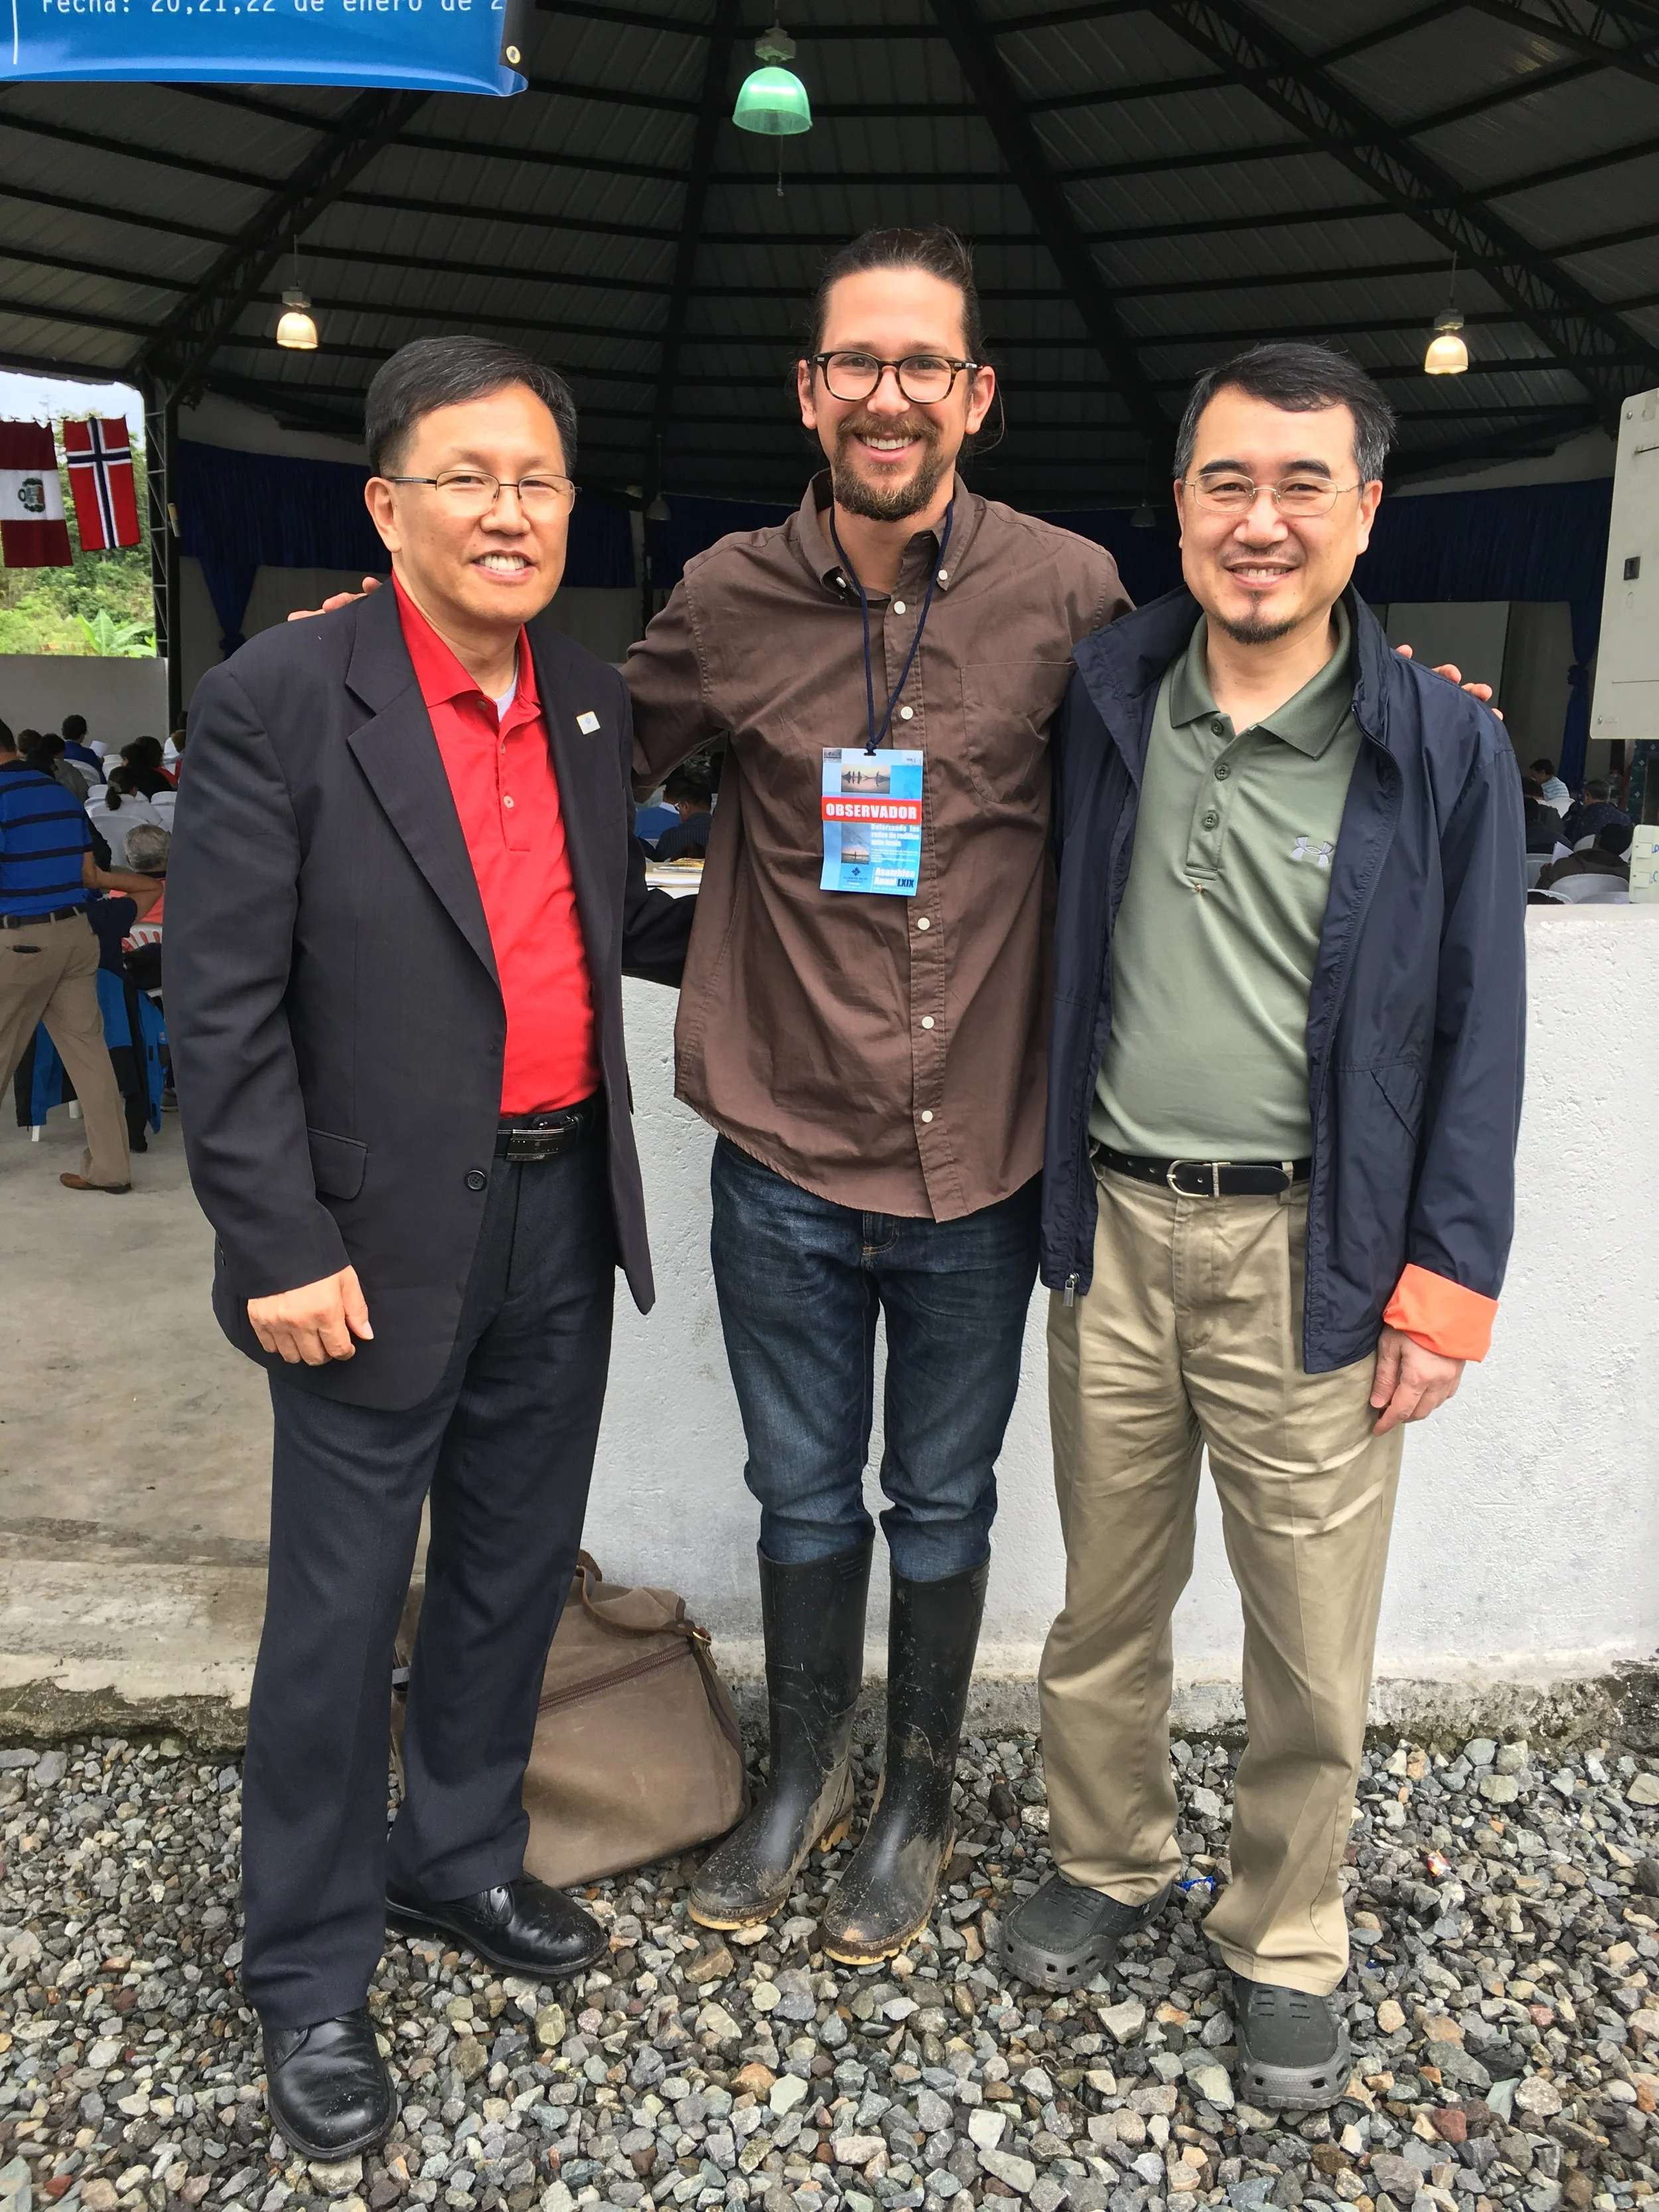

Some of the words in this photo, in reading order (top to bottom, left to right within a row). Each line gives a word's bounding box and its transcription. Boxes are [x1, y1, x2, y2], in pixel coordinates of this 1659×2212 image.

[294, 0, 324, 12] de
[343, 0, 422, 11] enero
[441, 0, 471, 11] de
[826, 803, 917, 820] OBSERVADOR
[875, 867, 915, 878] Asamblea
[897, 878, 914, 887] LXIX
